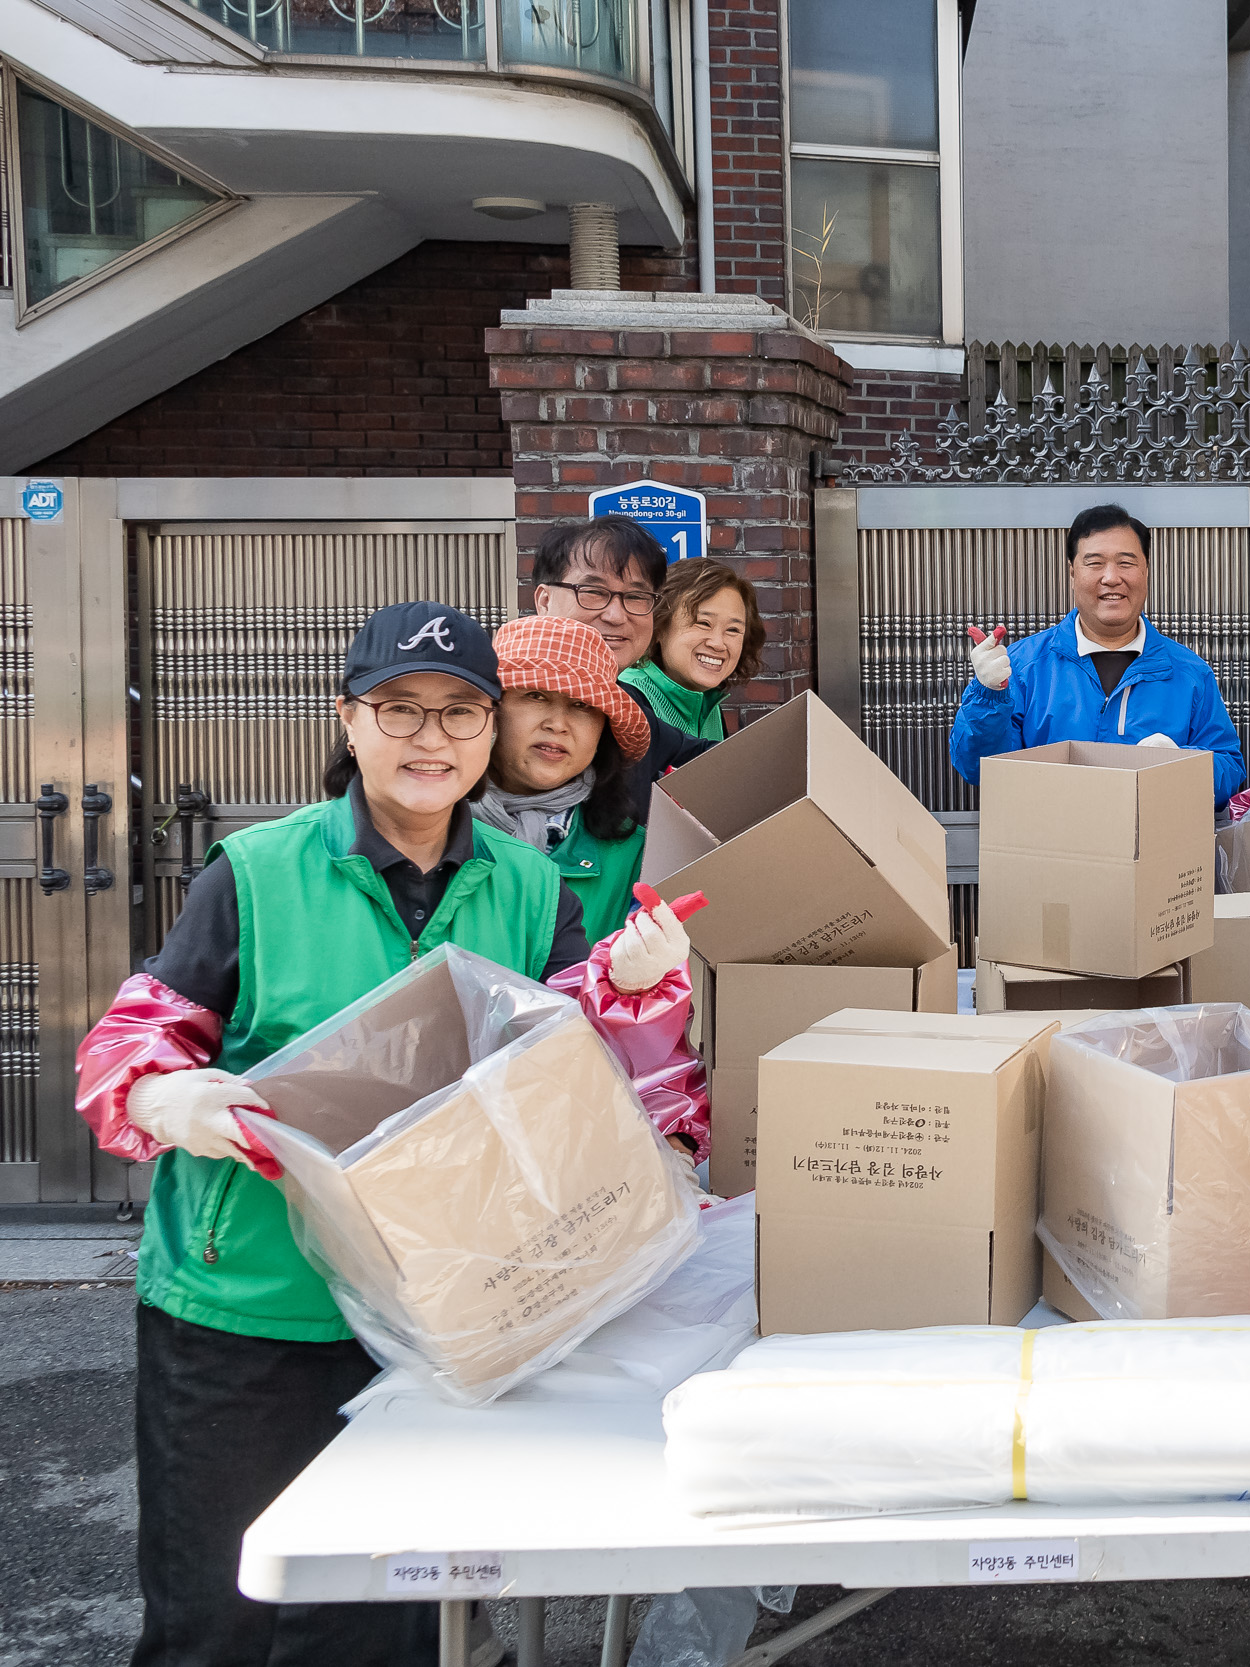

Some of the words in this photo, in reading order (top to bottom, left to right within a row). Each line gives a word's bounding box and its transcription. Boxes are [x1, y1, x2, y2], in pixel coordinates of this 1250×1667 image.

[29, 493, 57, 507] ADT
[618, 496, 676, 510] 능동로30길
[666, 510, 687, 519] 30-gil
[397, 616, 455, 652] A
[798, 941, 820, 956] 김장
[820, 910, 874, 943] 담가드리기
[875, 1102, 899, 1111] 자양점
[901, 1104, 926, 1113] 이마트
[884, 1116, 915, 1127] 광진구청
[842, 1128, 915, 1142] 광진구새마을부녀회
[934, 1134, 950, 1143] 주관
[815, 1141, 849, 1151] 11.13(수)
[863, 1144, 884, 1154] 12(화)
[902, 1148, 922, 1156] 2024.
[794, 1156, 861, 1174] 담가드리기
[867, 1162, 896, 1176] 김장
[812, 1174, 832, 1182] 보내기
[902, 1164, 943, 1181] 사랑의
[834, 1176, 849, 1184] 겨울
[852, 1178, 872, 1186] 따뜻한
[874, 1179, 896, 1188] 광진구
[898, 1180, 924, 1189] 2024년
[529, 1234, 558, 1259] 김장
[561, 1181, 631, 1236] 담가드리기
[1067, 1214, 1088, 1236] 사랑의
[1091, 1226, 1106, 1245] 김장
[1108, 1236, 1146, 1267] 담가드리기
[972, 1556, 1017, 1571] 자양3동
[1024, 1554, 1074, 1570] 주민센터
[394, 1566, 442, 1581] 자양3동
[448, 1564, 502, 1580] 주민센터
